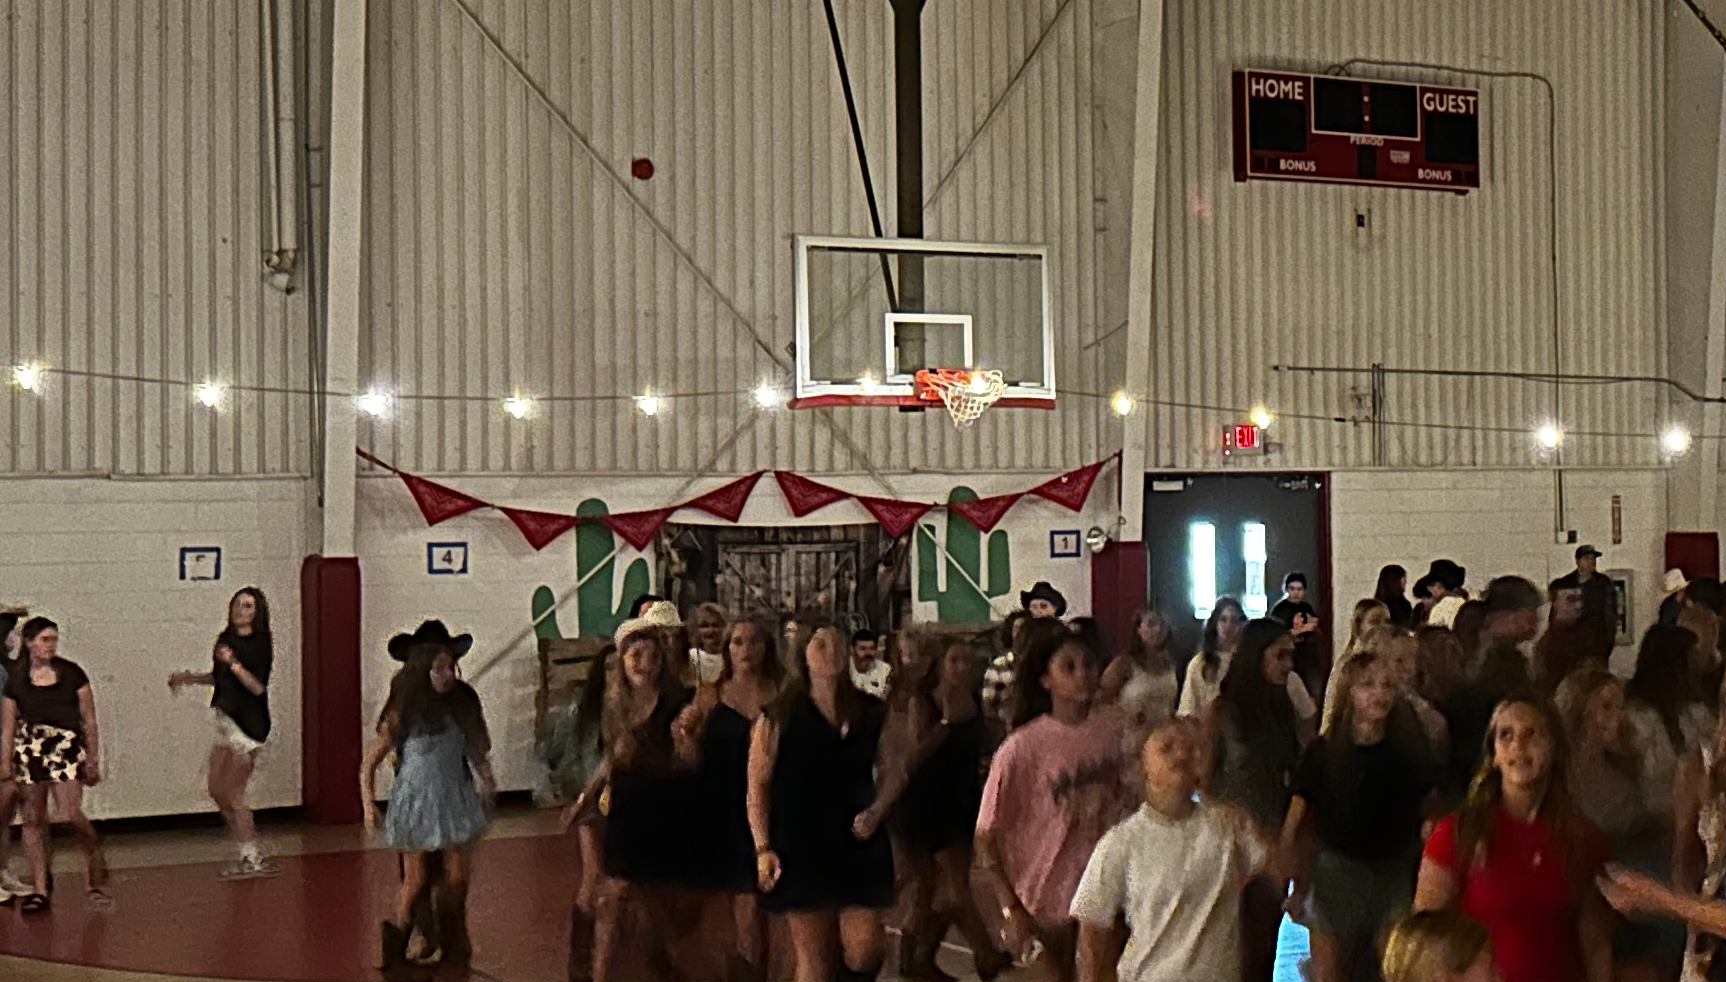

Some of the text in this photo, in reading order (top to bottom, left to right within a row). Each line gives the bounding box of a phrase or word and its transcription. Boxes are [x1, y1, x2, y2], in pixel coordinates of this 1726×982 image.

[1251, 77, 1304, 100] HOME
[1423, 92, 1477, 115] GUEST
[1350, 135, 1384, 147] PERIOD
[1279, 158, 1316, 172] BONUS
[1418, 168, 1452, 182] BONUS
[1235, 426, 1260, 448] EXIT
[1062, 536, 1069, 550] 1
[441, 549, 453, 565] 4
